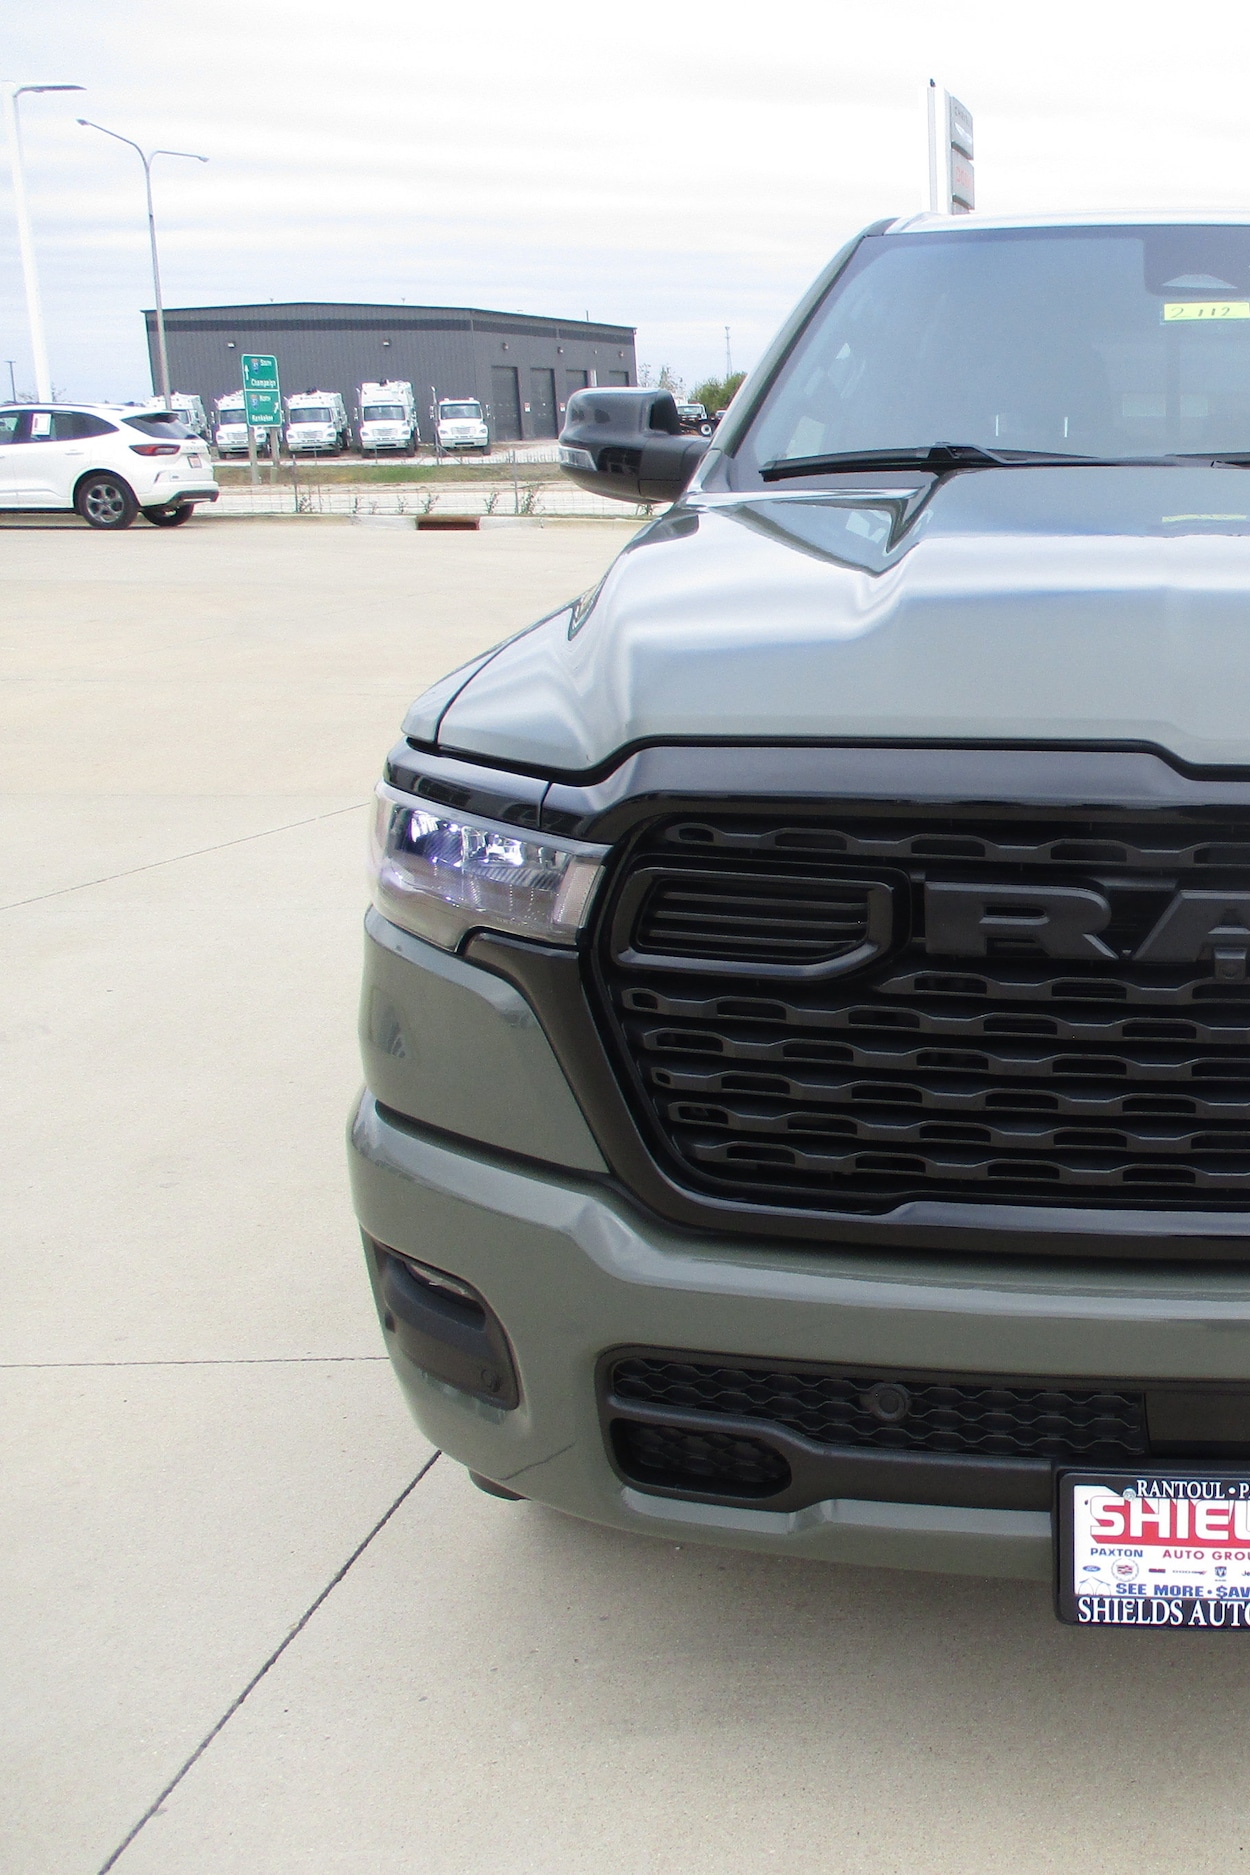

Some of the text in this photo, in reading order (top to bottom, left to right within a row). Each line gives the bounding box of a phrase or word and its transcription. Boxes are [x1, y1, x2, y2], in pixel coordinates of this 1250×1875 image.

[1136, 1480, 1225, 1499] RANTOUL
[1090, 1547, 1144, 1558] PAXTON
[1162, 1549, 1205, 1560] AUTO
[1115, 1583, 1147, 1595] SEE
[1154, 1584, 1204, 1597] MORE
[1077, 1596, 1184, 1624] SHIELDS
